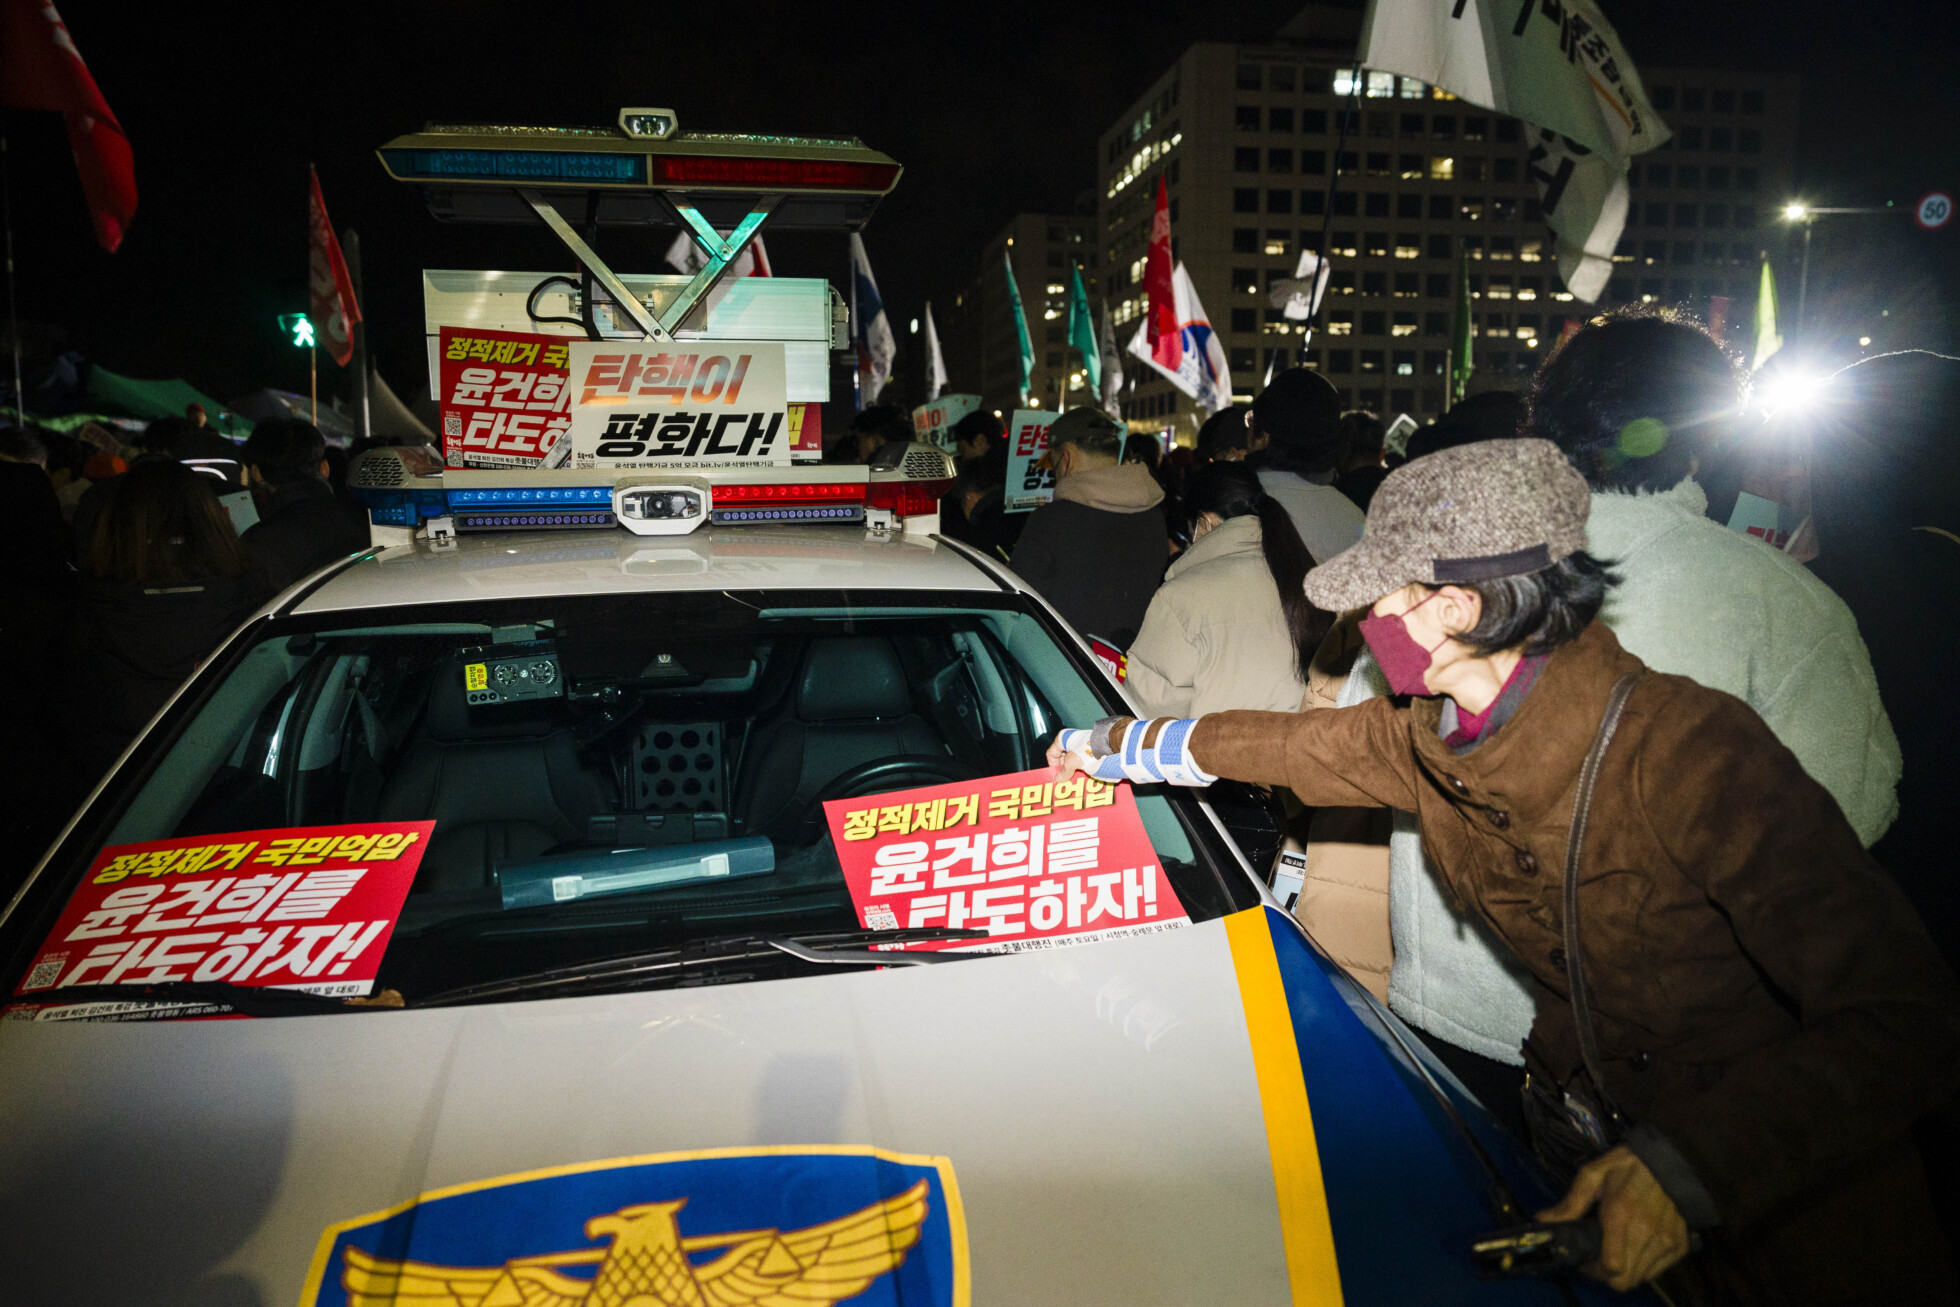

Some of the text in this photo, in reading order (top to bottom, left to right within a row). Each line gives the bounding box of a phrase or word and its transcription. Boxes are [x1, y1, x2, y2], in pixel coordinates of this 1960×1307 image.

[1923, 200, 1946, 219] 50
[446, 337, 541, 366] 정적제거
[579, 353, 752, 405] 탄핵이
[596, 412, 784, 457] 평화다!
[843, 778, 1115, 842] 정적제거 국민억압
[93, 832, 420, 884] 정적제거 국민억압
[870, 817, 1100, 897] 윤건희를
[64, 869, 368, 942] 윤건희를
[56, 919, 389, 988] 타도하자!
[1075, 934, 1098, 945] 토요일
[186, 1007, 202, 1016] ARS
[337, 985, 360, 994] 대로)
